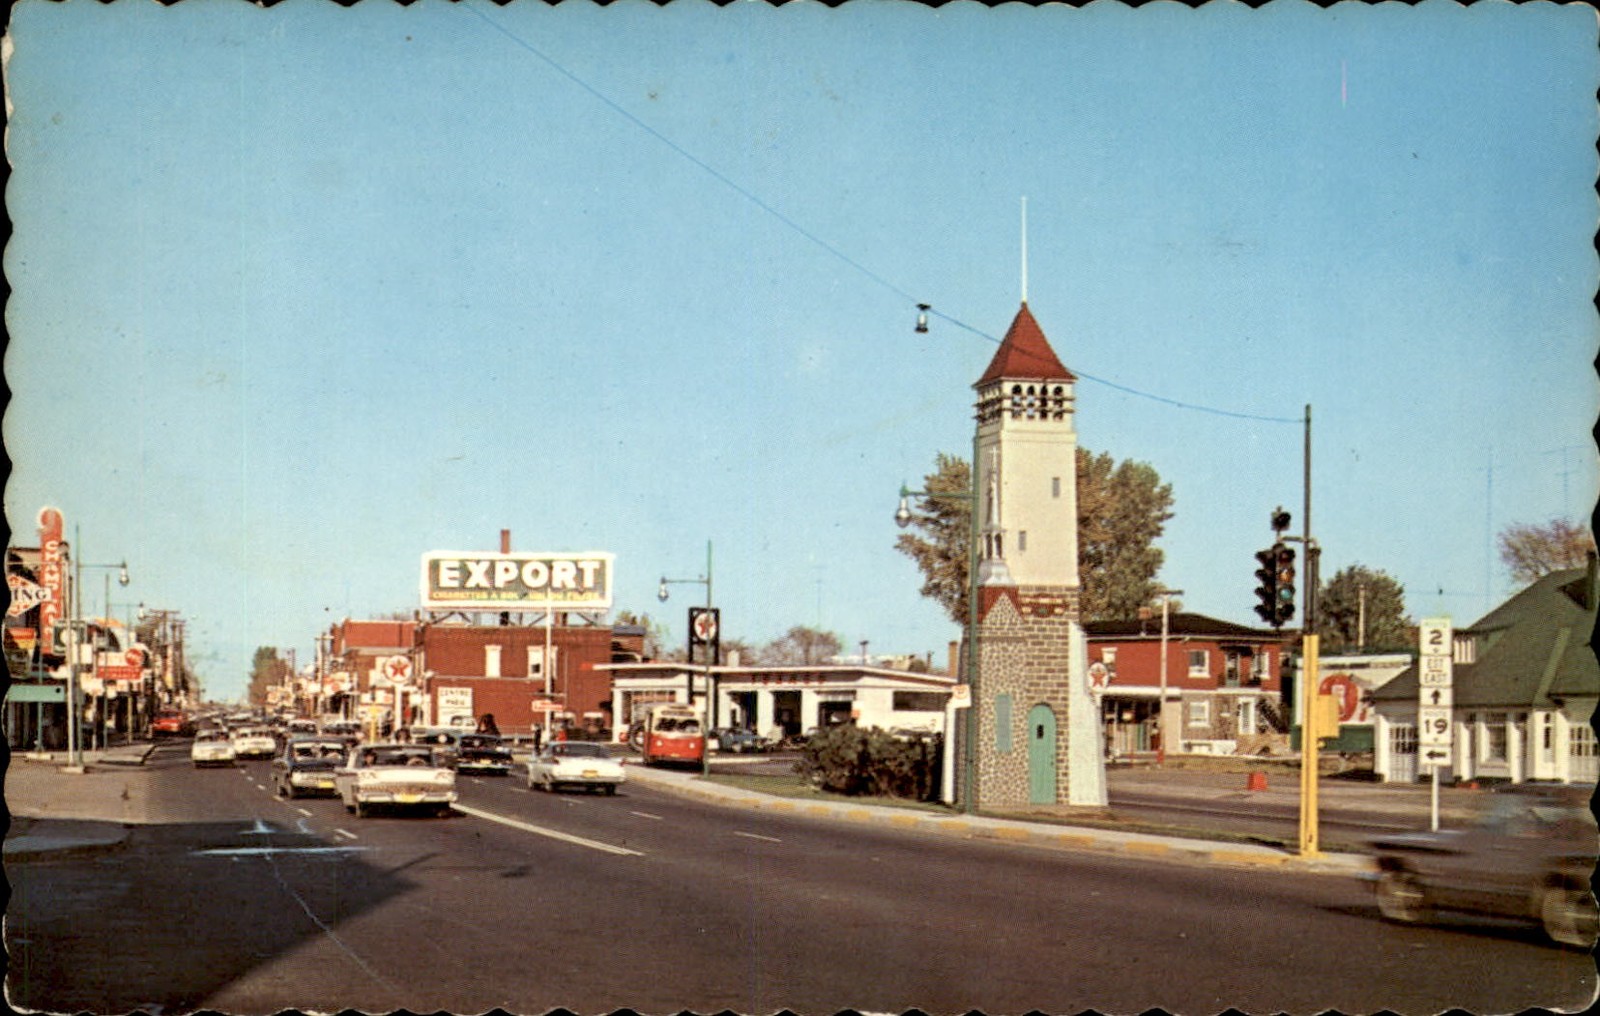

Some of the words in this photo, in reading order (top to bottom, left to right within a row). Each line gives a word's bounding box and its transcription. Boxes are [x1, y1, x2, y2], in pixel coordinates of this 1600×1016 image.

[439, 560, 600, 588] EXPORT
[1429, 629, 1443, 645] 2
[1424, 673, 1448, 684] EAST
[1425, 718, 1448, 734] 19
